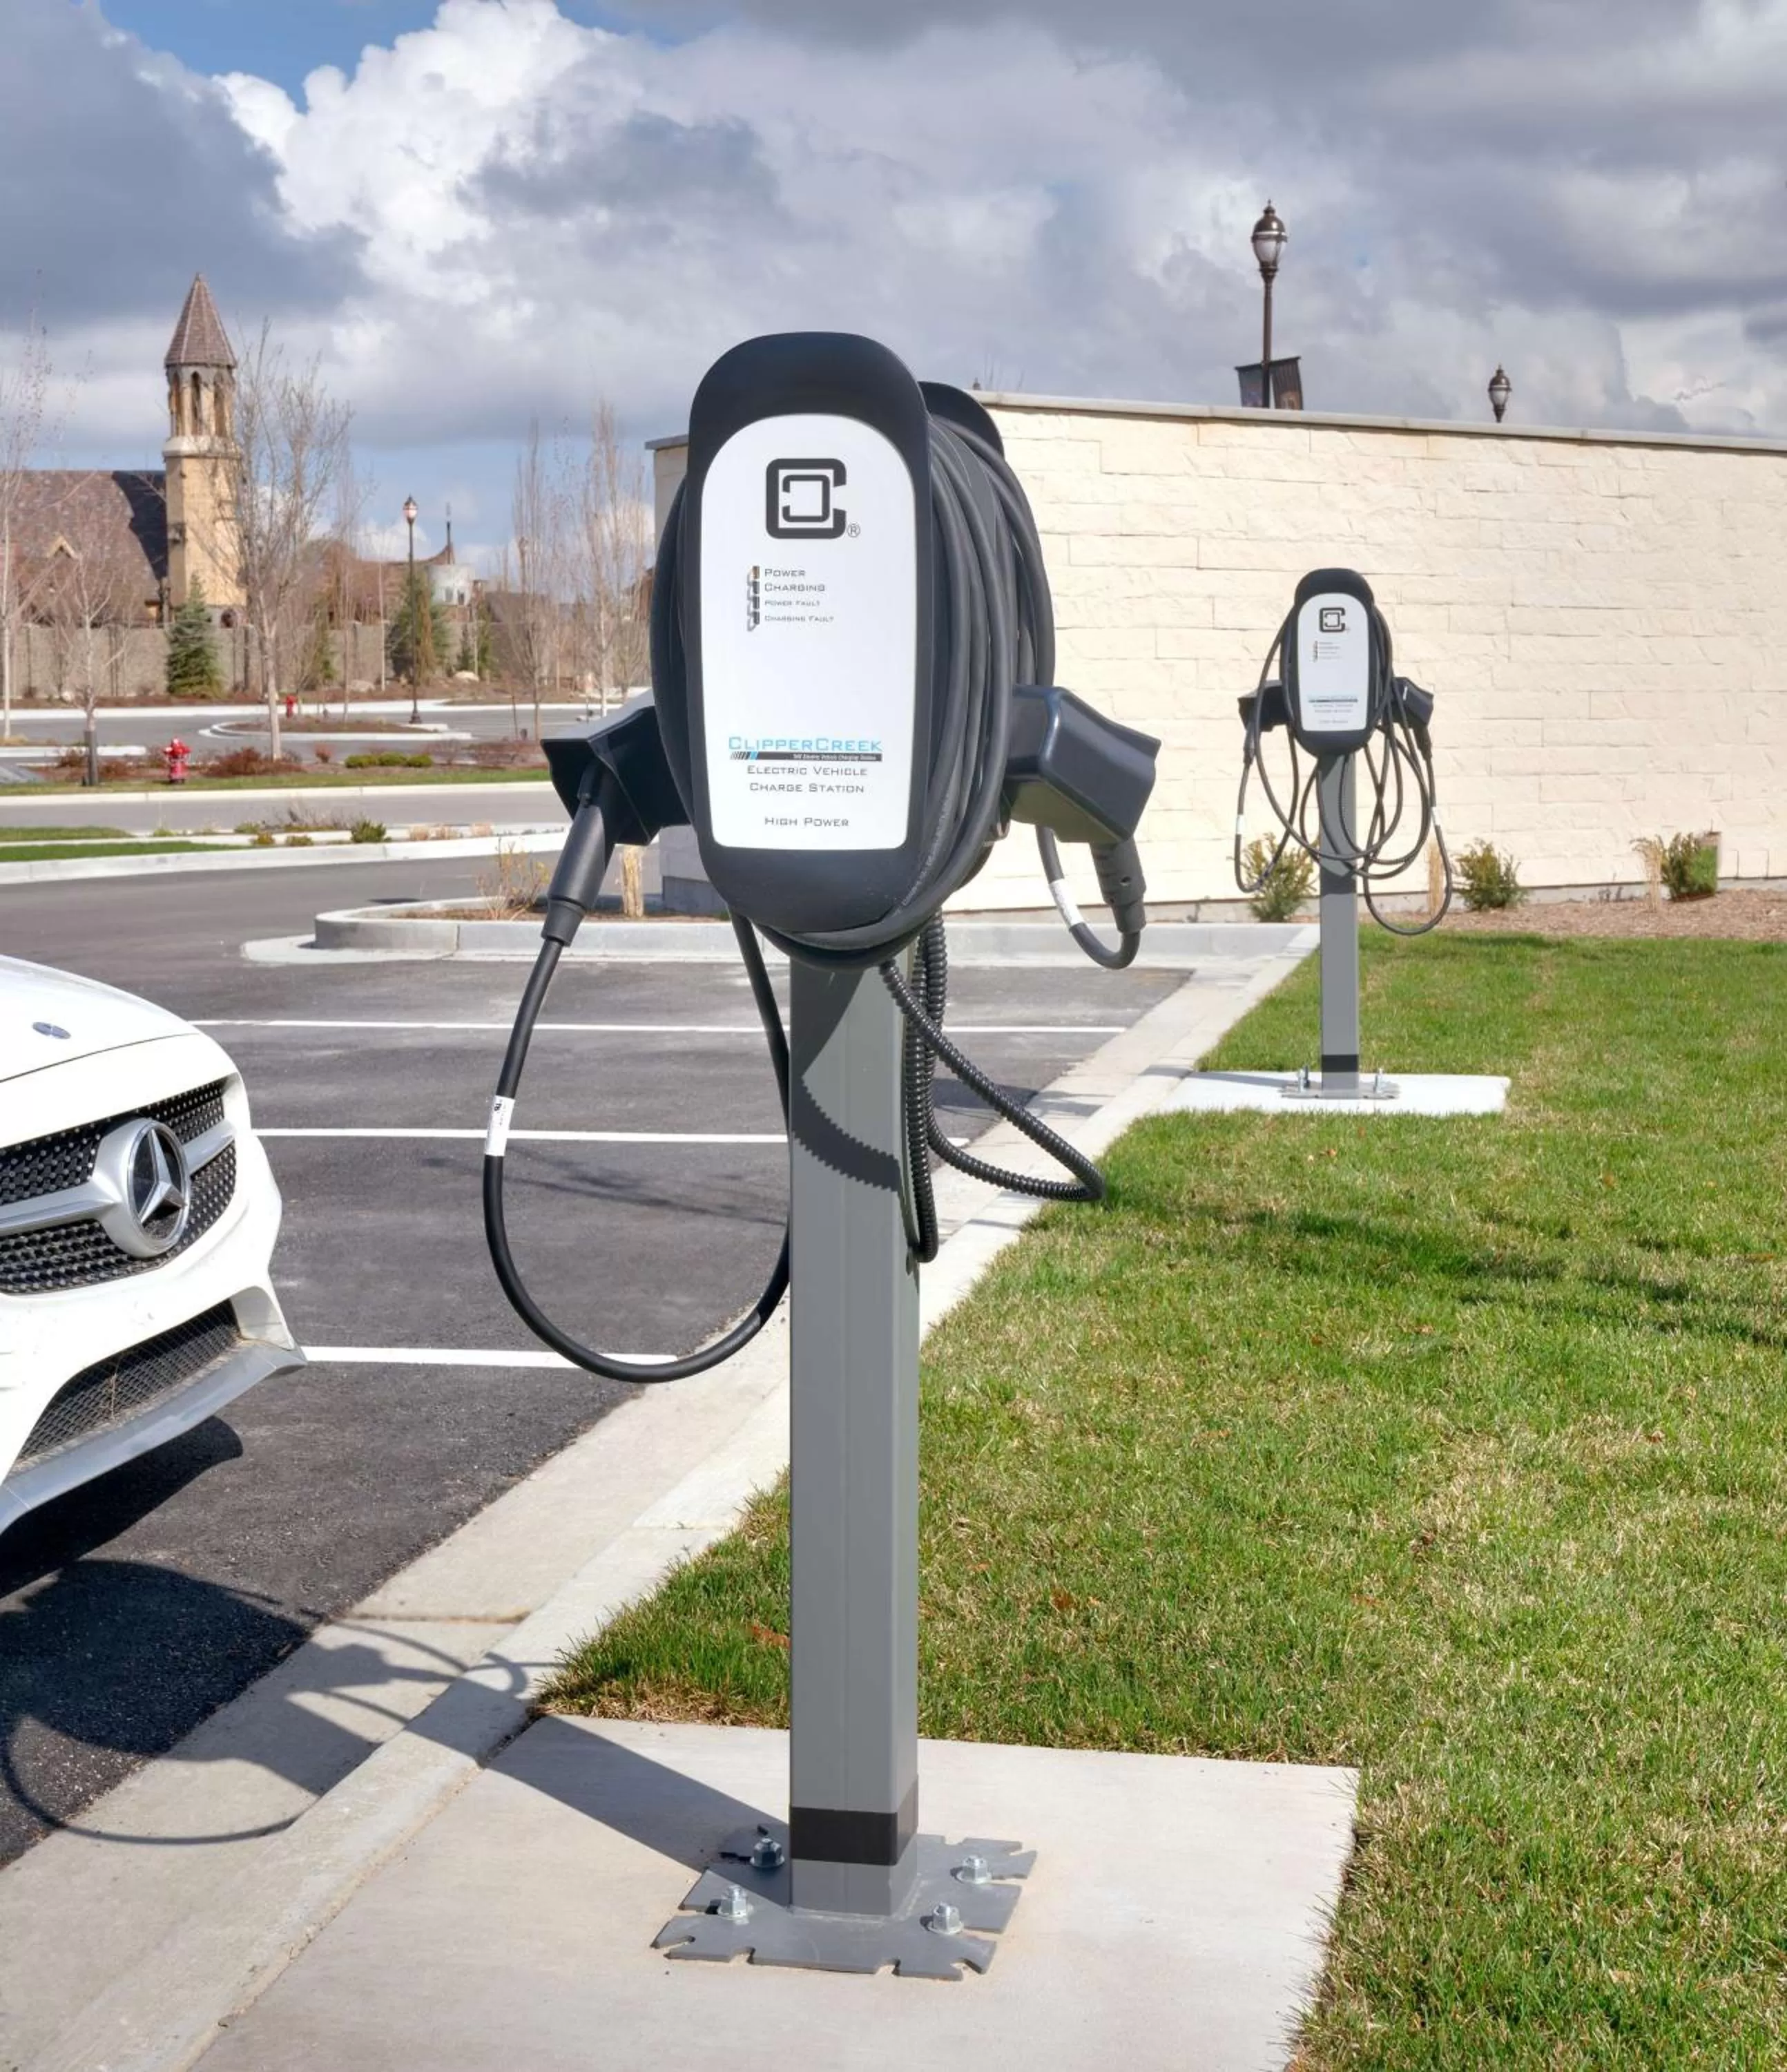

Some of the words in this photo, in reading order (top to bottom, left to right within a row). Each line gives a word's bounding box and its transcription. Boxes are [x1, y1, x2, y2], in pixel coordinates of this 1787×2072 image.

[764, 568, 806, 577] POWER
[746, 765, 807, 775] ELECTRIC
[813, 766, 868, 776] VEHICLE
[749, 783, 803, 792] CHARGE
[809, 783, 864, 794] STATION
[764, 817, 798, 827] HIGH
[804, 817, 849, 827] POWER
